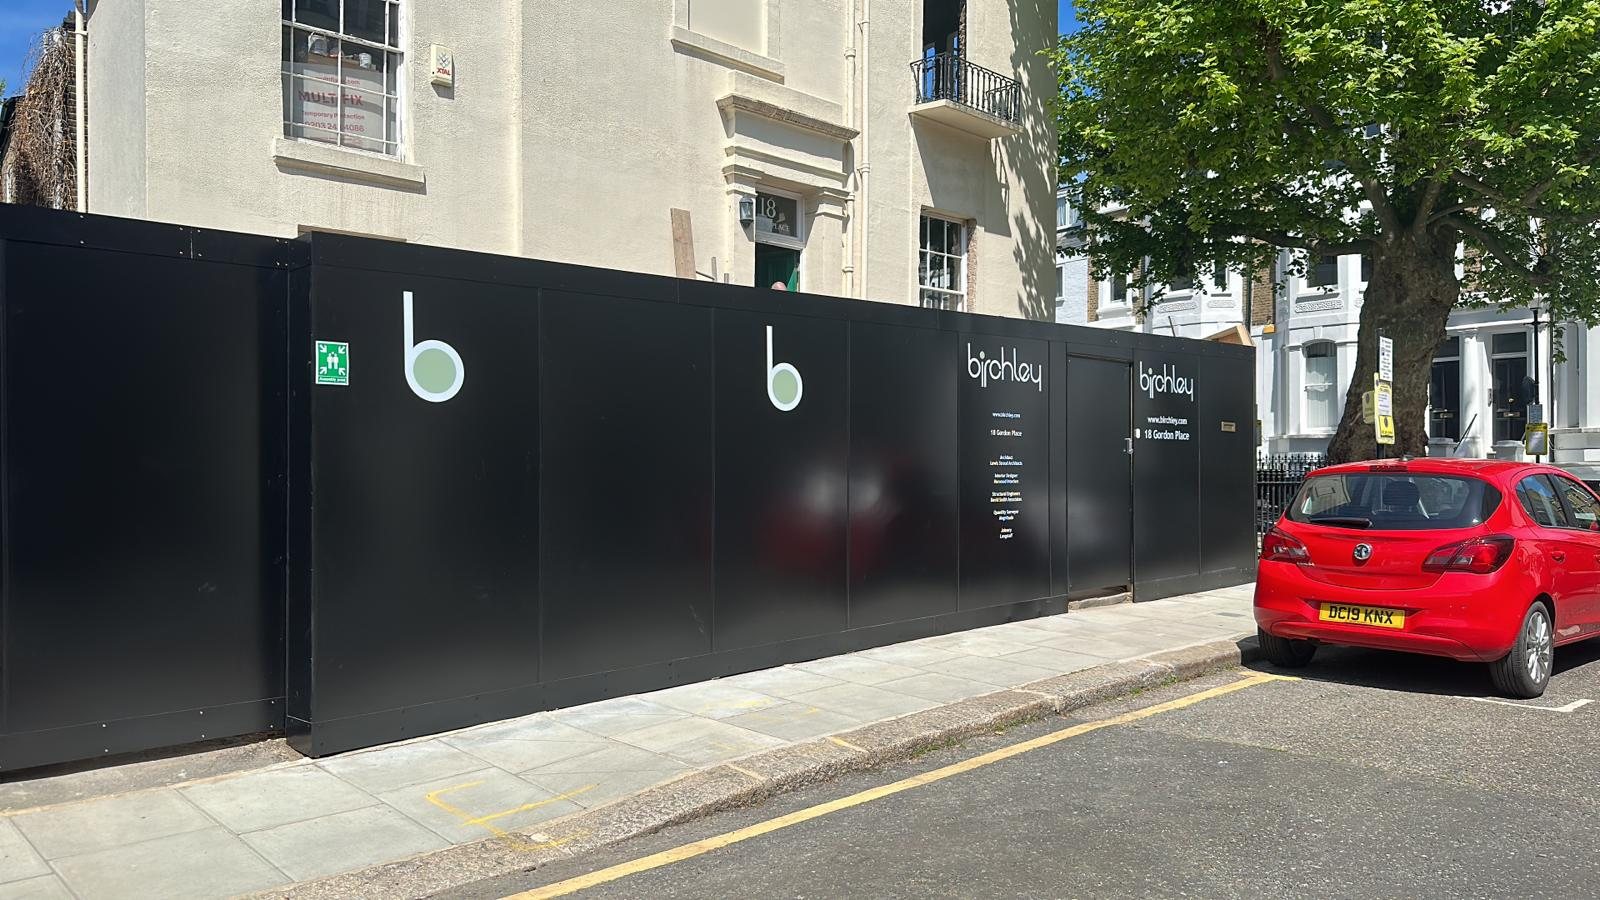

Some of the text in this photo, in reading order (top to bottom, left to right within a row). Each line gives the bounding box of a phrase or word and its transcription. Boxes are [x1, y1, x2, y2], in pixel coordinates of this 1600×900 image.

[760, 197, 776, 218] 18
[967, 342, 1042, 392] birchley
[1139, 360, 1194, 402] birchley
[1147, 415, 1188, 425] www.birchley.com
[1144, 429, 1190, 440] 18 Gordon Place
[1328, 606, 1394, 624] DC19 KNX
